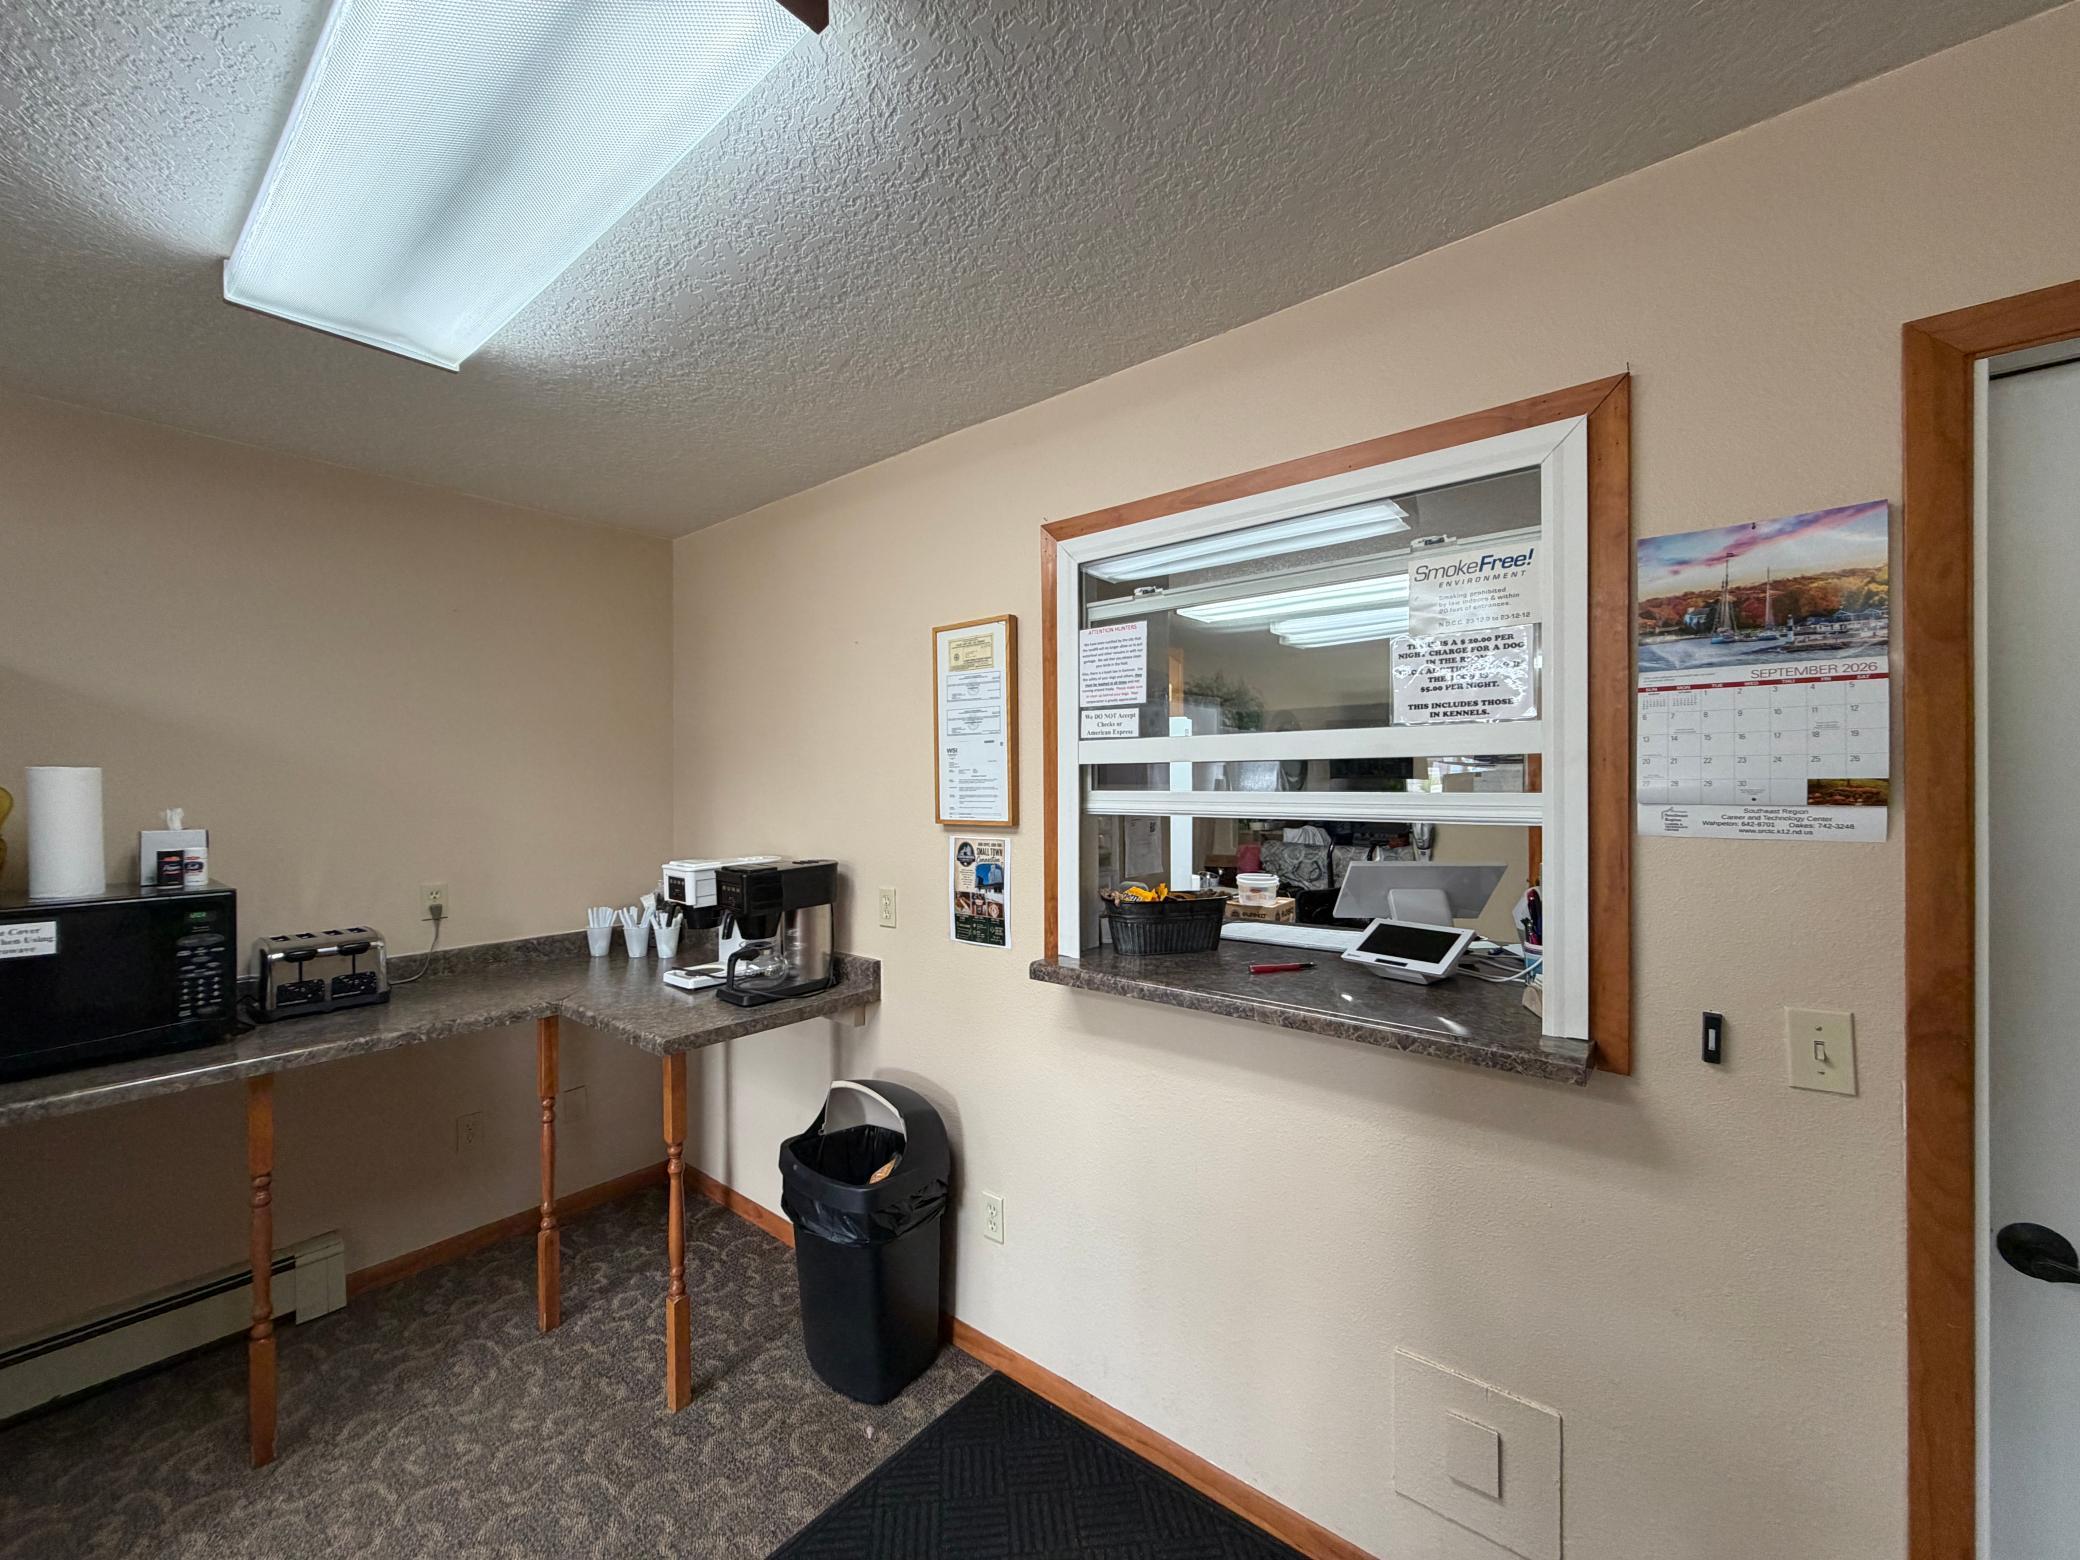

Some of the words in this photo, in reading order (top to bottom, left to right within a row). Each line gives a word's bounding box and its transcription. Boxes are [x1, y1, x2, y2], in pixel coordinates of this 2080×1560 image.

[1438, 570, 1527, 589] ENVIRONMENT
[1469, 587, 1507, 599] prohibited
[1497, 592, 1520, 600] within
[1088, 627, 1114, 635] ATTENTION
[1114, 624, 1137, 632] HUNTERS
[1468, 636, 1492, 644] 20.00
[1494, 633, 1514, 641] PER
[1429, 647, 1469, 657] CHARGE
[1470, 645, 1490, 653] FOR
[1492, 643, 1500, 651] A
[1503, 641, 1525, 650] DOG
[1439, 657, 1458, 665] THE
[1751, 664, 1838, 678] SEPTEMBER
[1842, 662, 1878, 673] 2026
[1445, 683, 1464, 691] PER
[1465, 680, 1500, 689] NIGHT.
[1408, 703, 1429, 711] THIS
[1431, 700, 1479, 709] INCLUDES
[1480, 698, 1514, 706] THOSE
[1119, 712, 1136, 720] Accept
[1442, 709, 1490, 718] KENNELS.
[976, 847, 990, 857] SMALL
[990, 848, 1003, 857] TOWN
